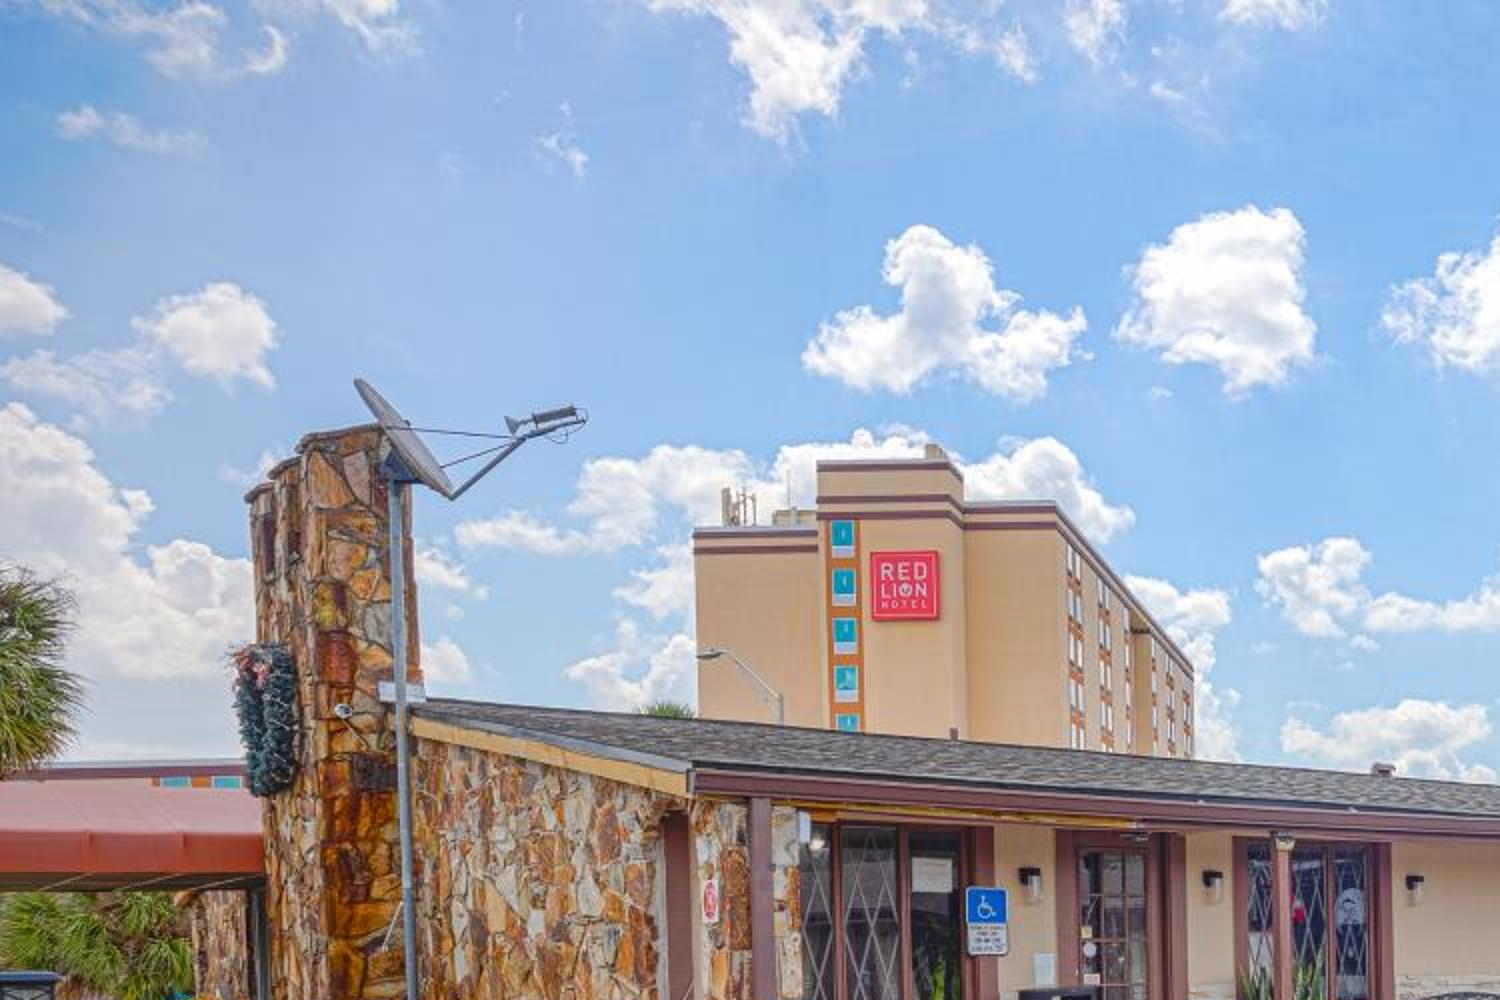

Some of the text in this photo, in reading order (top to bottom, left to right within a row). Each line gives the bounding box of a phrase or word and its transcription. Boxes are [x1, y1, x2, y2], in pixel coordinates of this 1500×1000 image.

[881, 562, 928, 580] RED
[881, 582, 928, 598] LION
[881, 600, 928, 609] HOTEL
